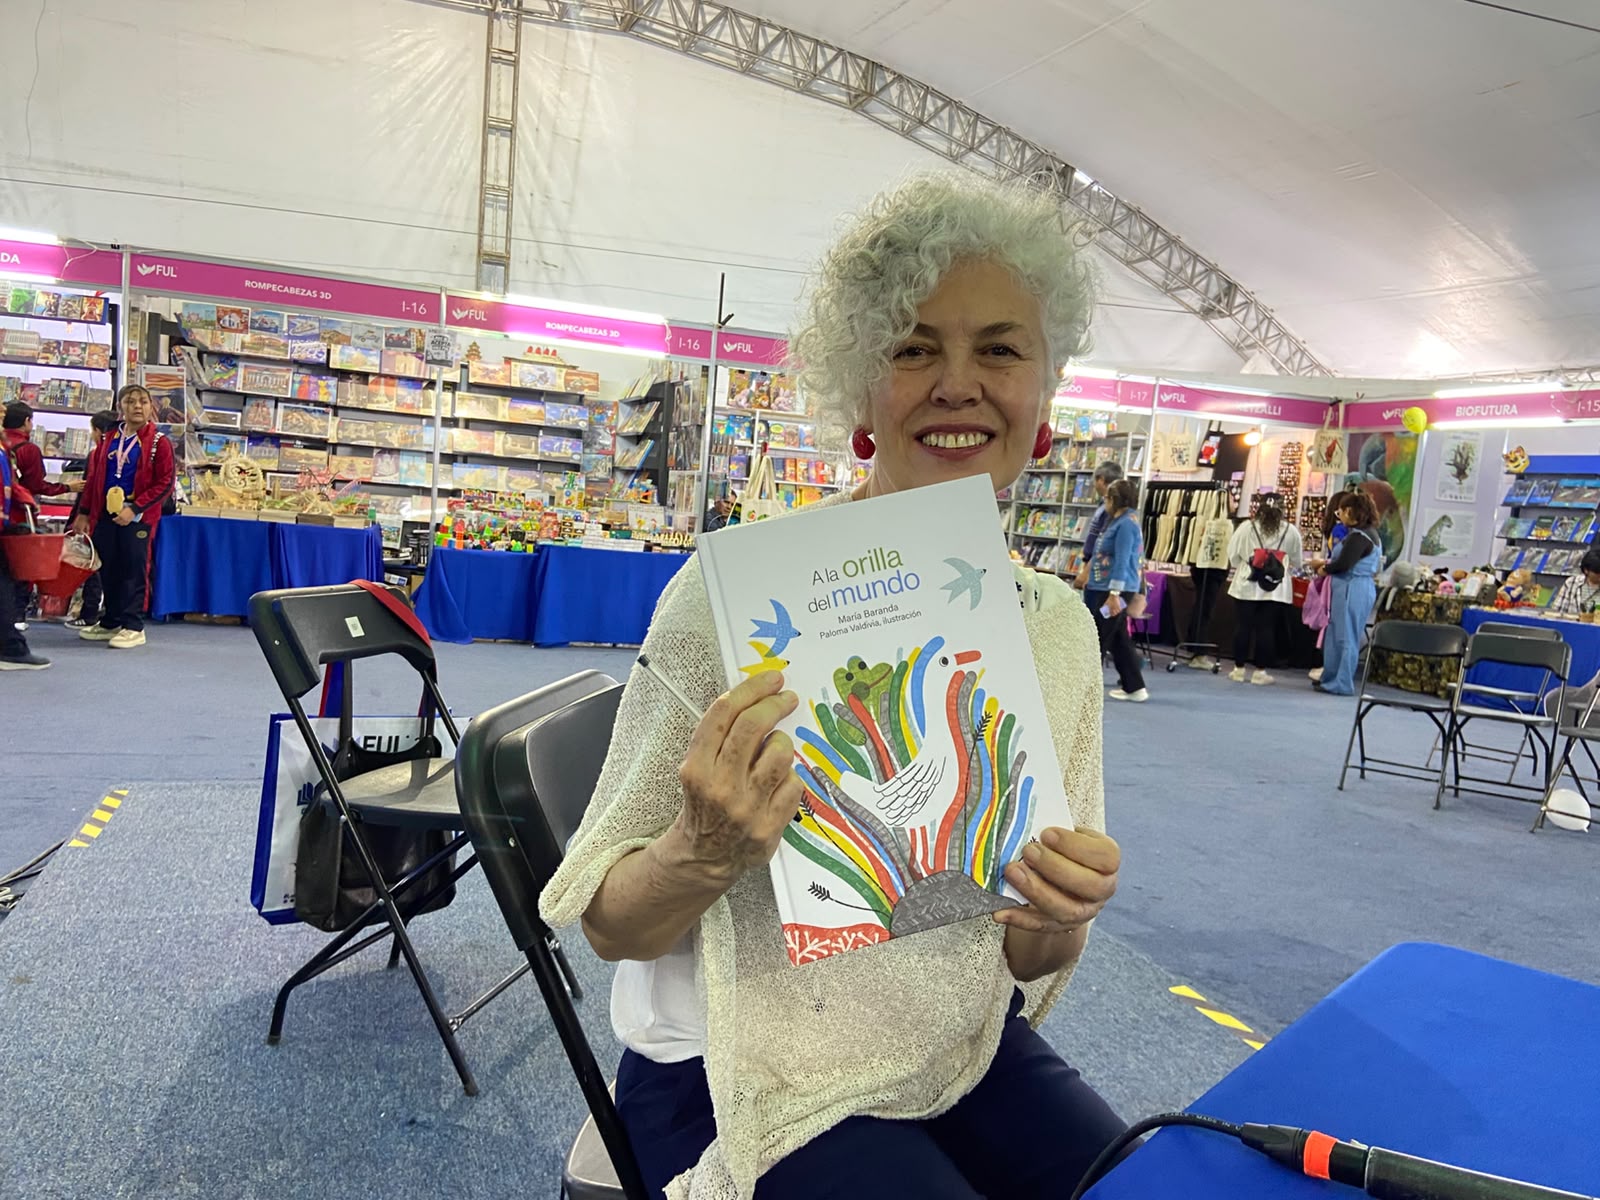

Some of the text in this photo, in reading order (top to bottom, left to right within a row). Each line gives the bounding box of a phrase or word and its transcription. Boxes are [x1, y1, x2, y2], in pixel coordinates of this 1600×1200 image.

[156, 265, 177, 278] FUL
[245, 280, 332, 300] ROMPECABEZAS 3D
[402, 301, 427, 315] I-16
[469, 310, 487, 321] FUL
[545, 322, 620, 338] ROMPECABEZAS 3D
[679, 337, 700, 350] I-16
[737, 342, 753, 353] FUL
[1130, 390, 1148, 401] I-17
[1173, 393, 1186, 403] FUL
[1455, 404, 1519, 417] BIOFUTURA
[812, 547, 904, 586] A la orilla
[808, 569, 920, 613] del mundo
[838, 603, 899, 624] María Baranda
[819, 610, 922, 639] Paloma Valdivia, ilustración
